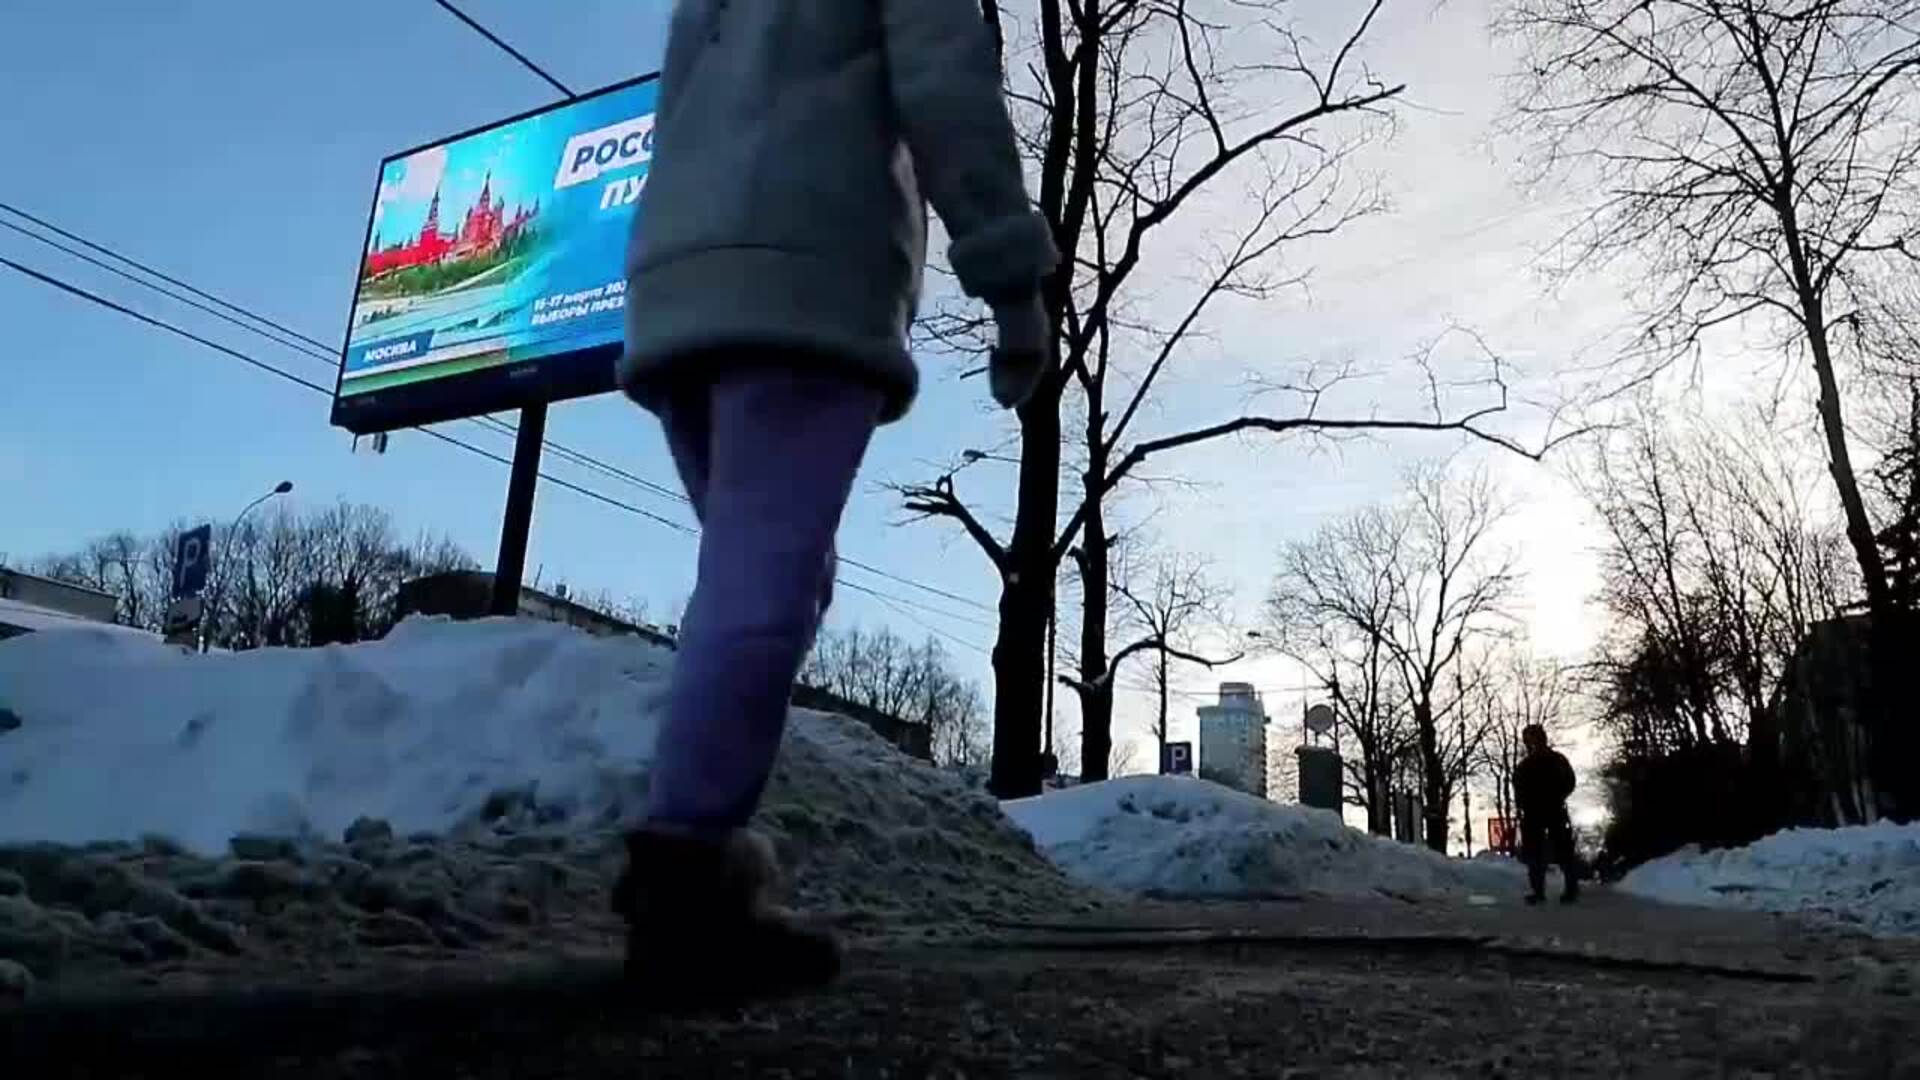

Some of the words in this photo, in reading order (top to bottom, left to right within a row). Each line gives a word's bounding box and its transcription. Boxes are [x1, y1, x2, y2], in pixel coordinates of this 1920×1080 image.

[600, 173, 649, 210] ПУ
[531, 303, 590, 325] ВЫБОРЫ
[362, 340, 417, 362] МОСКВА
[180, 538, 201, 589] P
[1171, 745, 1187, 769] P
